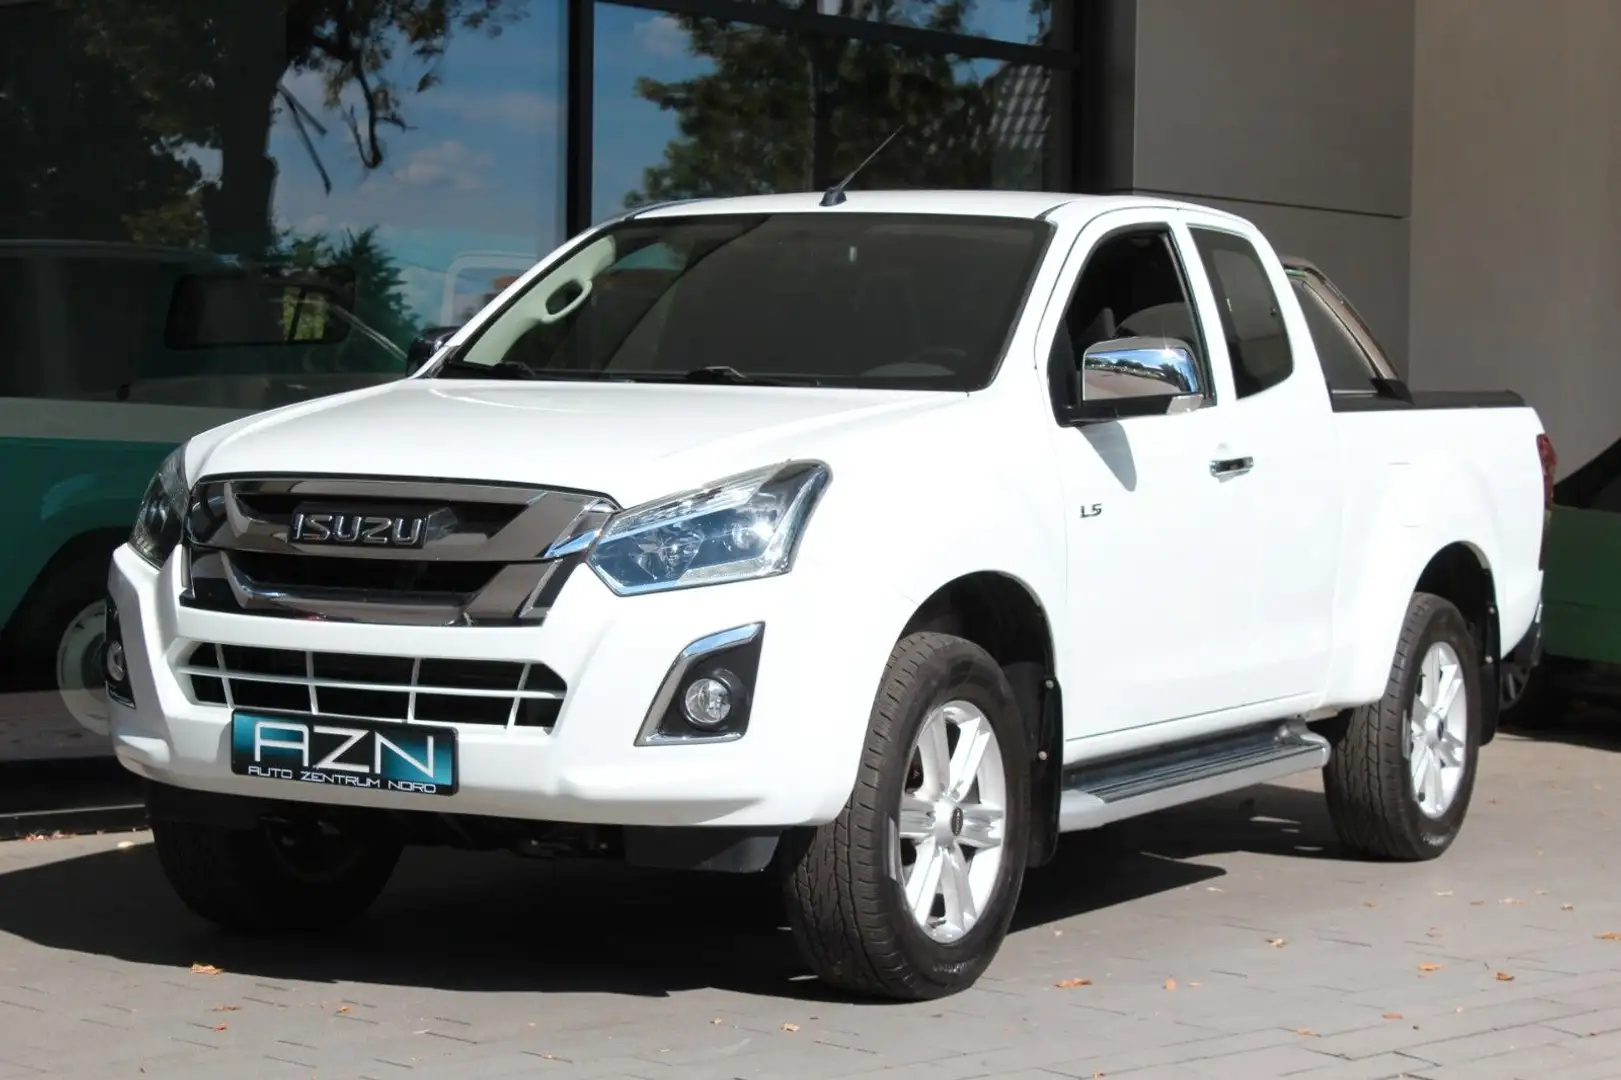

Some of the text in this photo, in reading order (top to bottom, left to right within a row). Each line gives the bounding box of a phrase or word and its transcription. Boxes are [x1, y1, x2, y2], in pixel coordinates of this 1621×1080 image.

[1080, 503, 1102, 518] LS
[294, 513, 423, 546] ISUZU
[254, 721, 434, 779] AZN
[248, 765, 437, 794] AUTO ZENTRUM NORD
